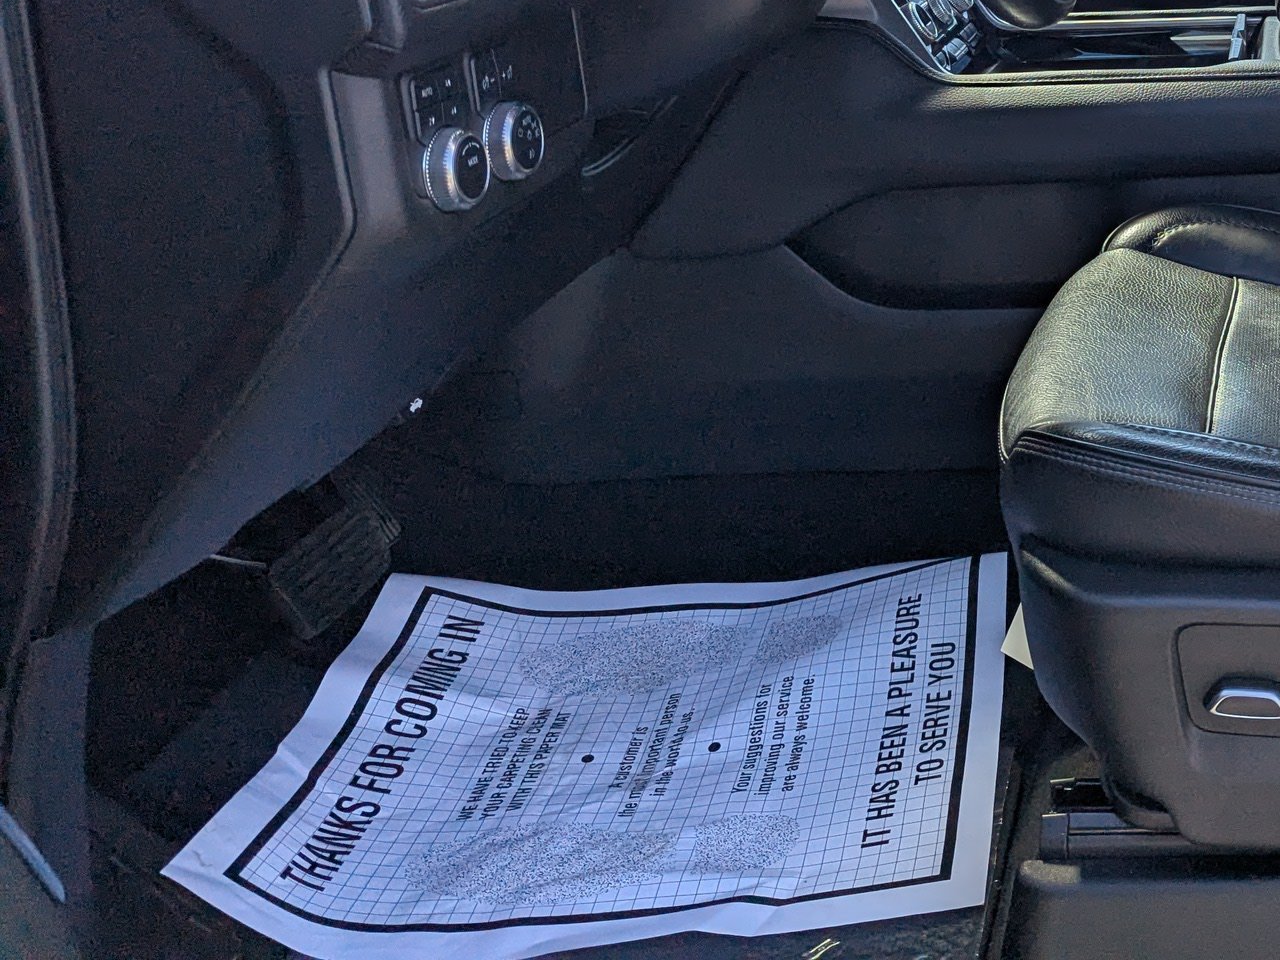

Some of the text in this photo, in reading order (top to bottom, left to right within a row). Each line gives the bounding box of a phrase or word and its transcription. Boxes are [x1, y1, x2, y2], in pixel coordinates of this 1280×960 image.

[280, 615, 484, 891] THANKS FOR COMING IN
[456, 708, 529, 820] WE HAVE TRIED TO KEEP
[479, 709, 552, 820] YOUR CARPETING CLEAN
[506, 712, 571, 812] WITH THIS PAPER MAT
[616, 737, 643, 780] customer
[618, 803, 637, 817] the
[637, 728, 668, 776] important
[659, 693, 682, 725] person
[649, 708, 695, 796] in the world to us.
[731, 684, 772, 793] Your suggestions for
[754, 676, 794, 795] improving our service
[782, 674, 815, 792] are always welcome.
[860, 593, 922, 848] IT HAS BEEN A PLEASURE
[914, 643, 956, 784] TO SERVE YOU
